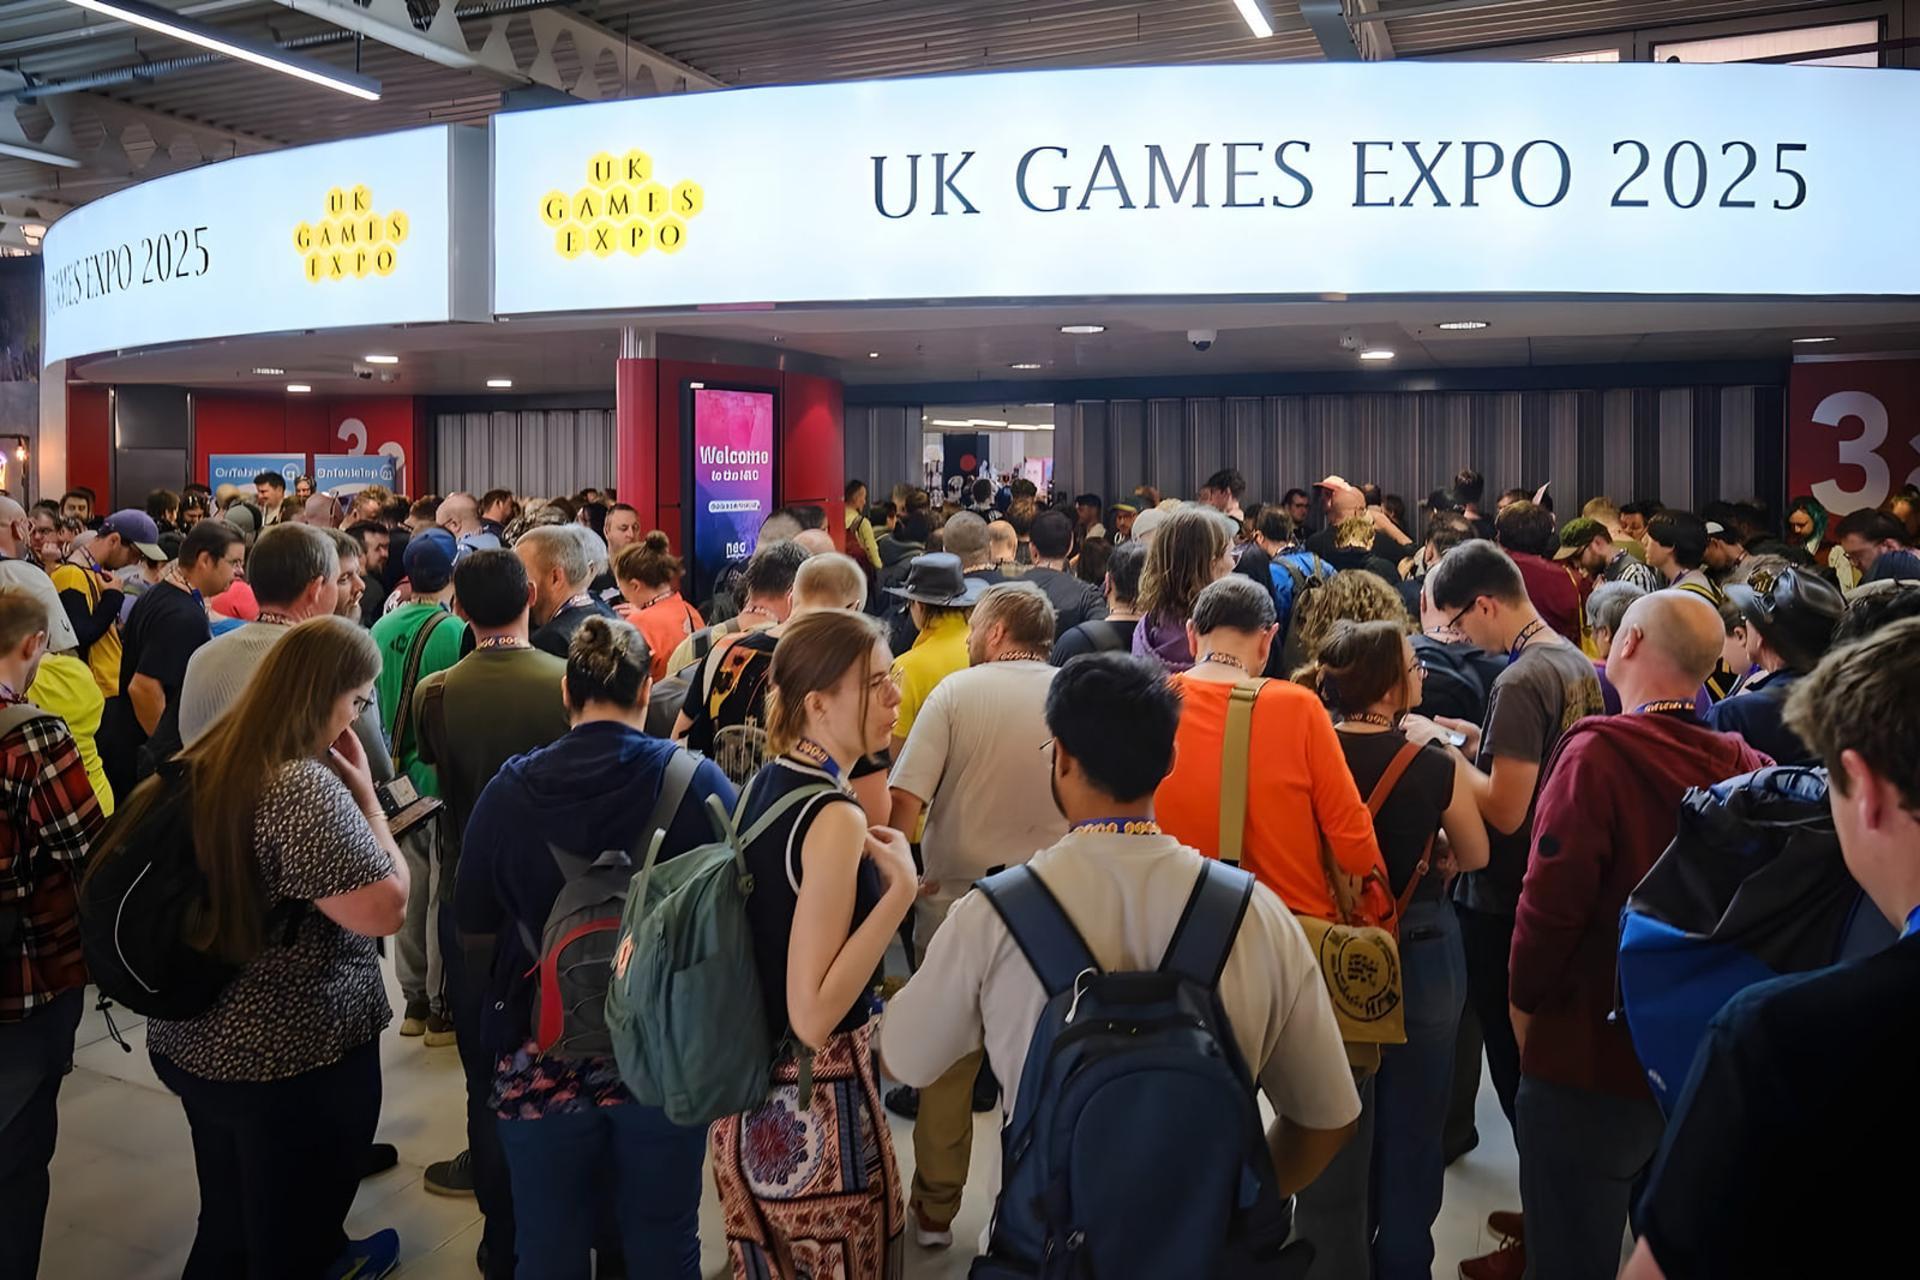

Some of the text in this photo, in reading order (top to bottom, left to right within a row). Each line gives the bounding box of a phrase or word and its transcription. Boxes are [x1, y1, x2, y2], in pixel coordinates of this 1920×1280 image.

[595, 157, 643, 182] UK
[870, 140, 1808, 218] UK GAMES EXPO 2025
[331, 191, 366, 213] UK
[546, 187, 694, 220] GAMES
[297, 216, 402, 248] GAMES
[565, 224, 680, 252] EXPO
[85, 243, 132, 299] EXPO
[141, 226, 209, 284] 2025
[310, 250, 391, 277] EXPO
[700, 445, 768, 464] Welcome
